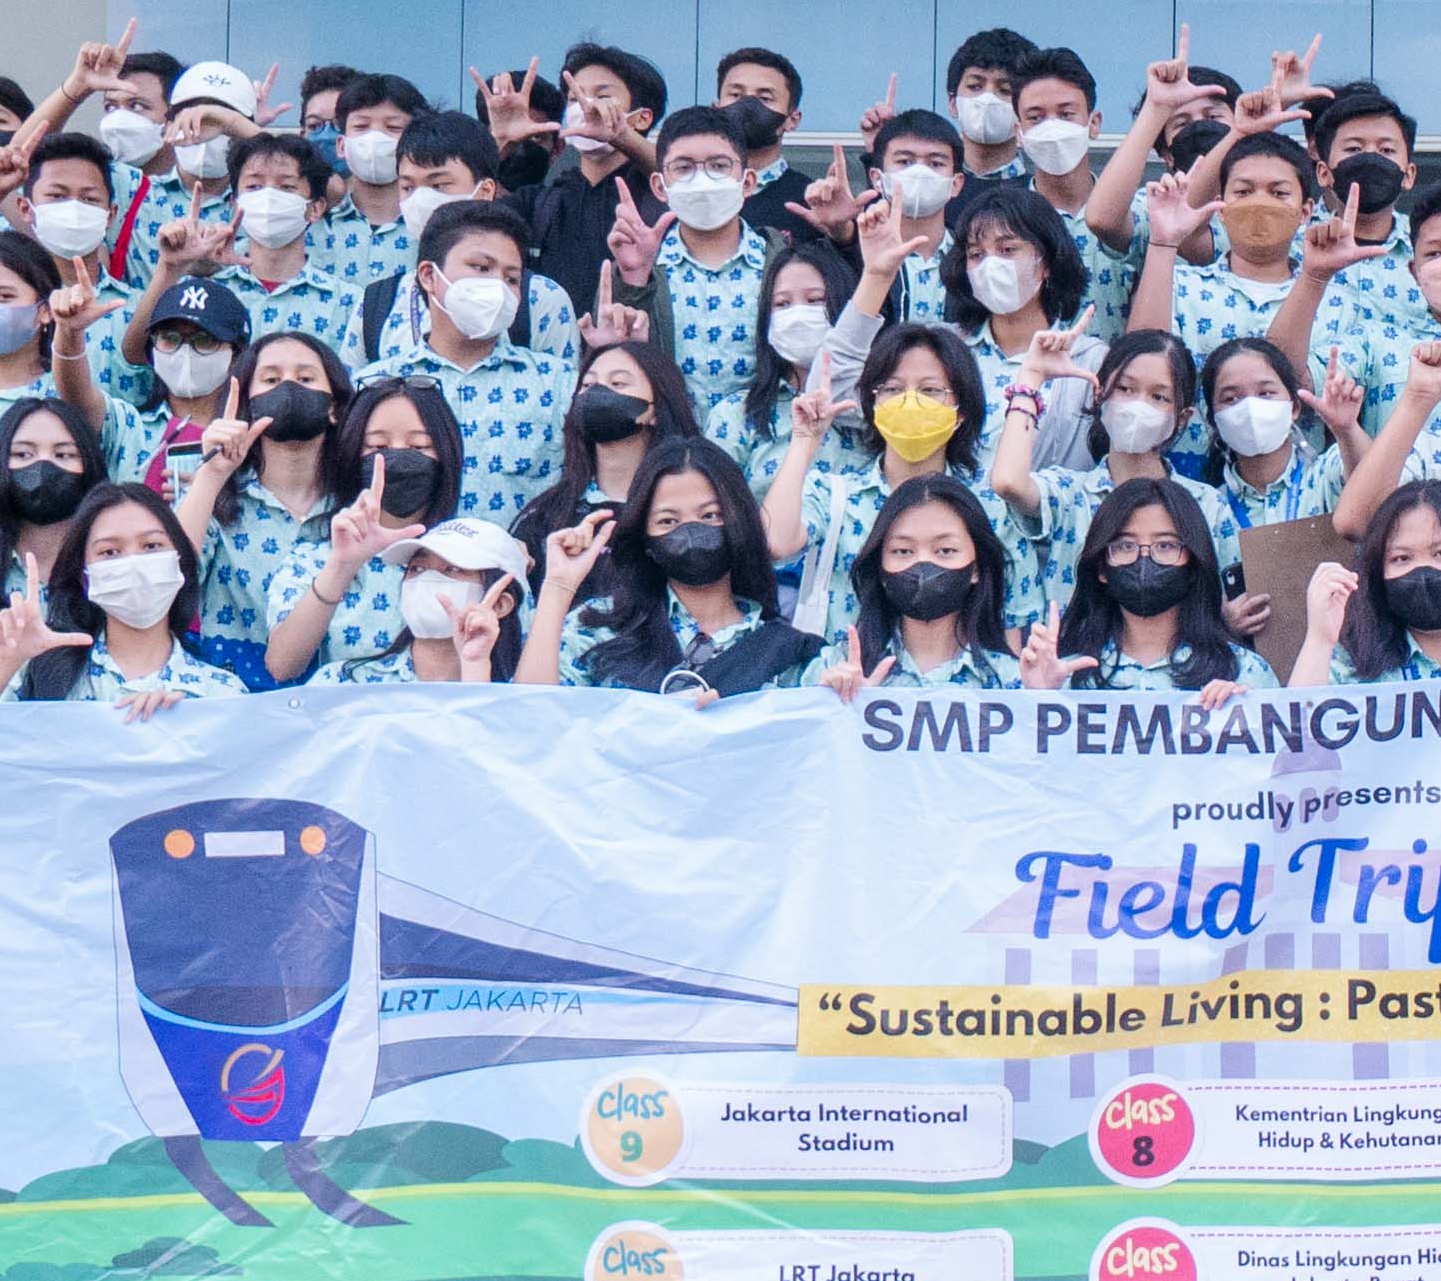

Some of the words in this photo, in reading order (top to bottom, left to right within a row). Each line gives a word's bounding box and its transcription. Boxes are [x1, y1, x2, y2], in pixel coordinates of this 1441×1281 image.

[862, 700, 1013, 754] SMP
[1172, 794, 1294, 829] proudly
[1303, 781, 1441, 822] presents
[1015, 843, 1267, 940] Field
[380, 990, 439, 1014] LRT
[446, 989, 584, 1015] JAKARTA
[1161, 981, 1303, 1032] Living
[721, 1103, 811, 1124] Jakarta
[819, 1105, 968, 1124] International
[1236, 1106, 1347, 1124] Kementrian
[620, 1131, 643, 1161] 9
[799, 1133, 894, 1152] Stadium
[1133, 1136, 1154, 1166] 8
[1258, 1132, 1314, 1151] Hidup
[1321, 1132, 1334, 1149] &
[1238, 1250, 1290, 1268] Dinas
[1296, 1249, 1412, 1271] Lingkungan
